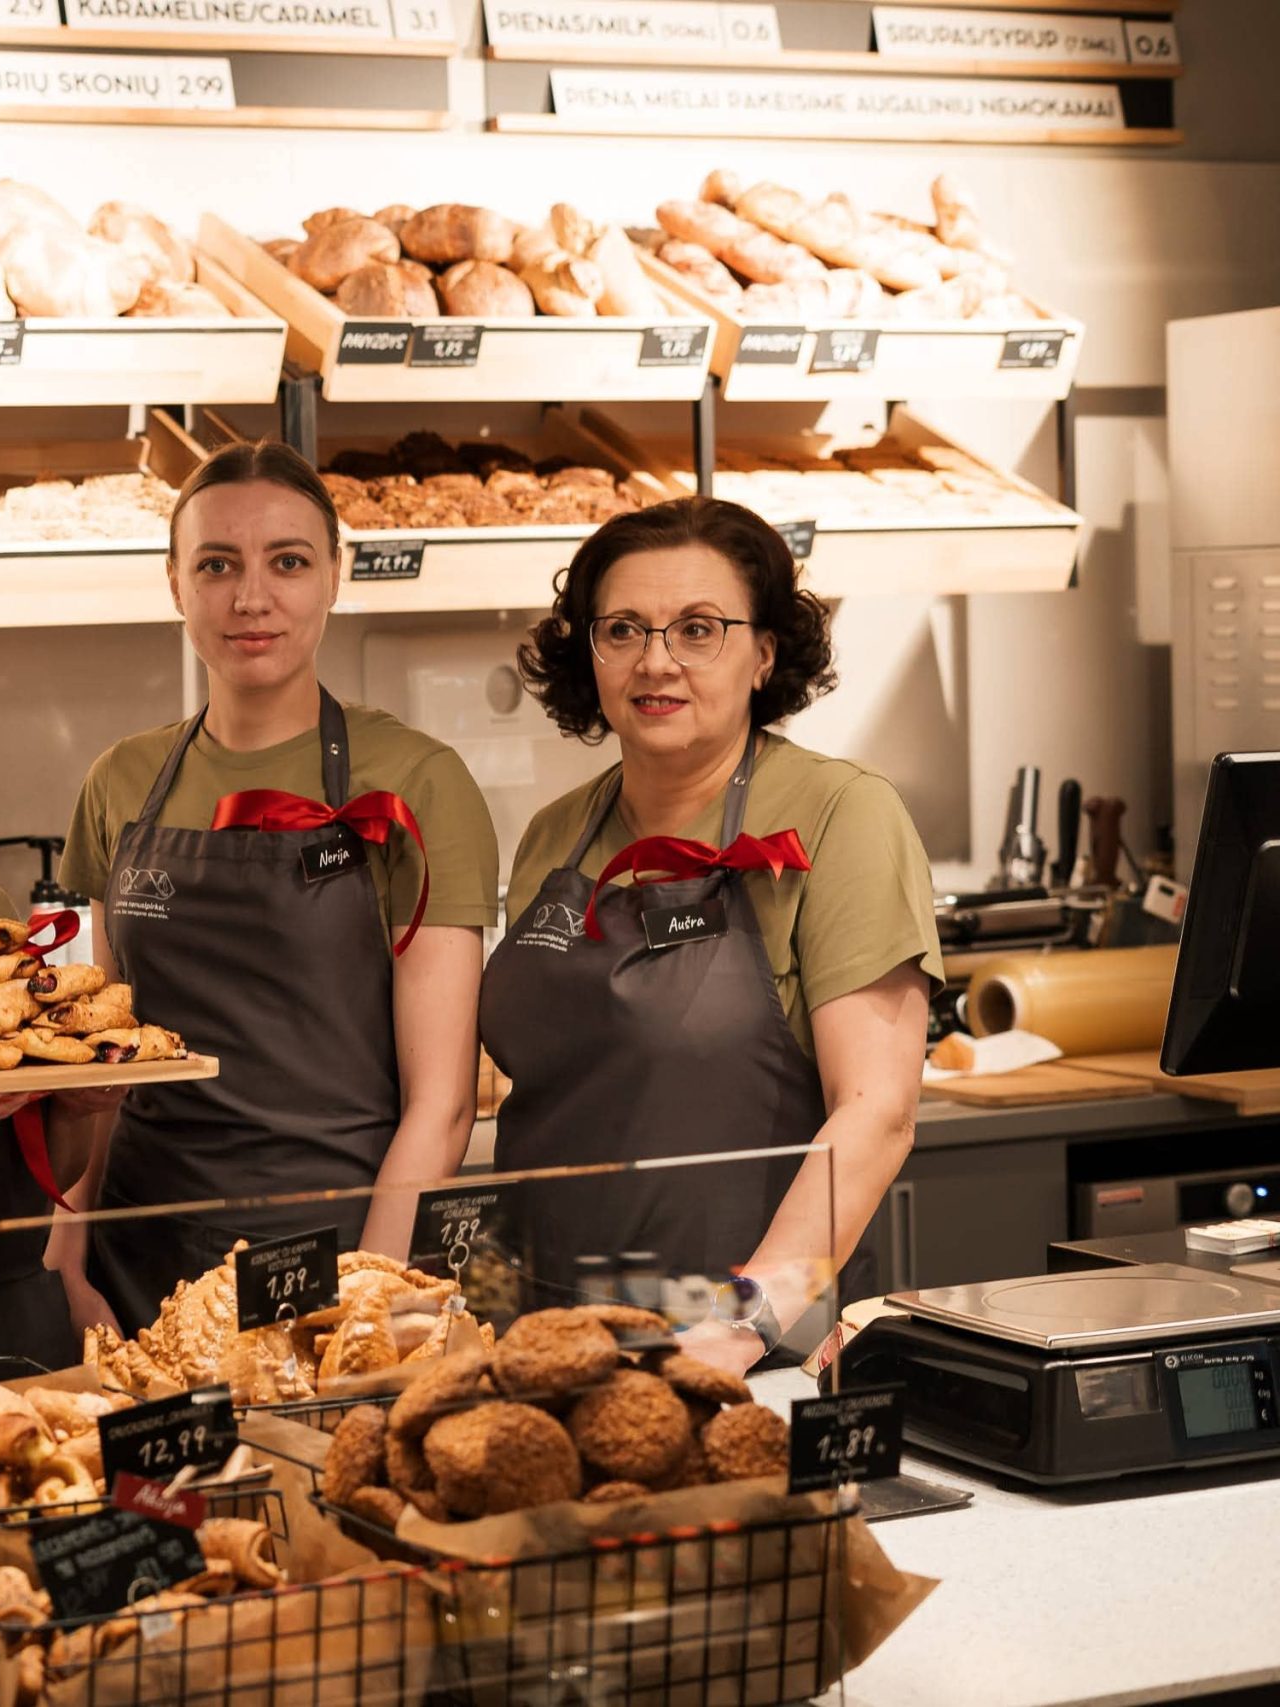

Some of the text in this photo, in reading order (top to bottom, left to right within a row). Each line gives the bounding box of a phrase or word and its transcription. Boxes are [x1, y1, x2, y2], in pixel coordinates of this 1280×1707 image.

[497, 11, 654, 38] PIENAS/MILK
[885, 22, 1059, 49] SIRUPAS/SYRUP
[58, 72, 161, 101] SKONIŲ
[643, 88, 720, 111] MIELAI
[729, 89, 847, 114] PAKEISIME
[980, 97, 1114, 119] NEMOKAMAI
[319, 847, 350, 868] Nerija
[668, 914, 706, 934] Aušra
[440, 1217, 481, 1246] 1,89
[266, 1265, 308, 1301] 1,89
[138, 1424, 207, 1468] 12,99
